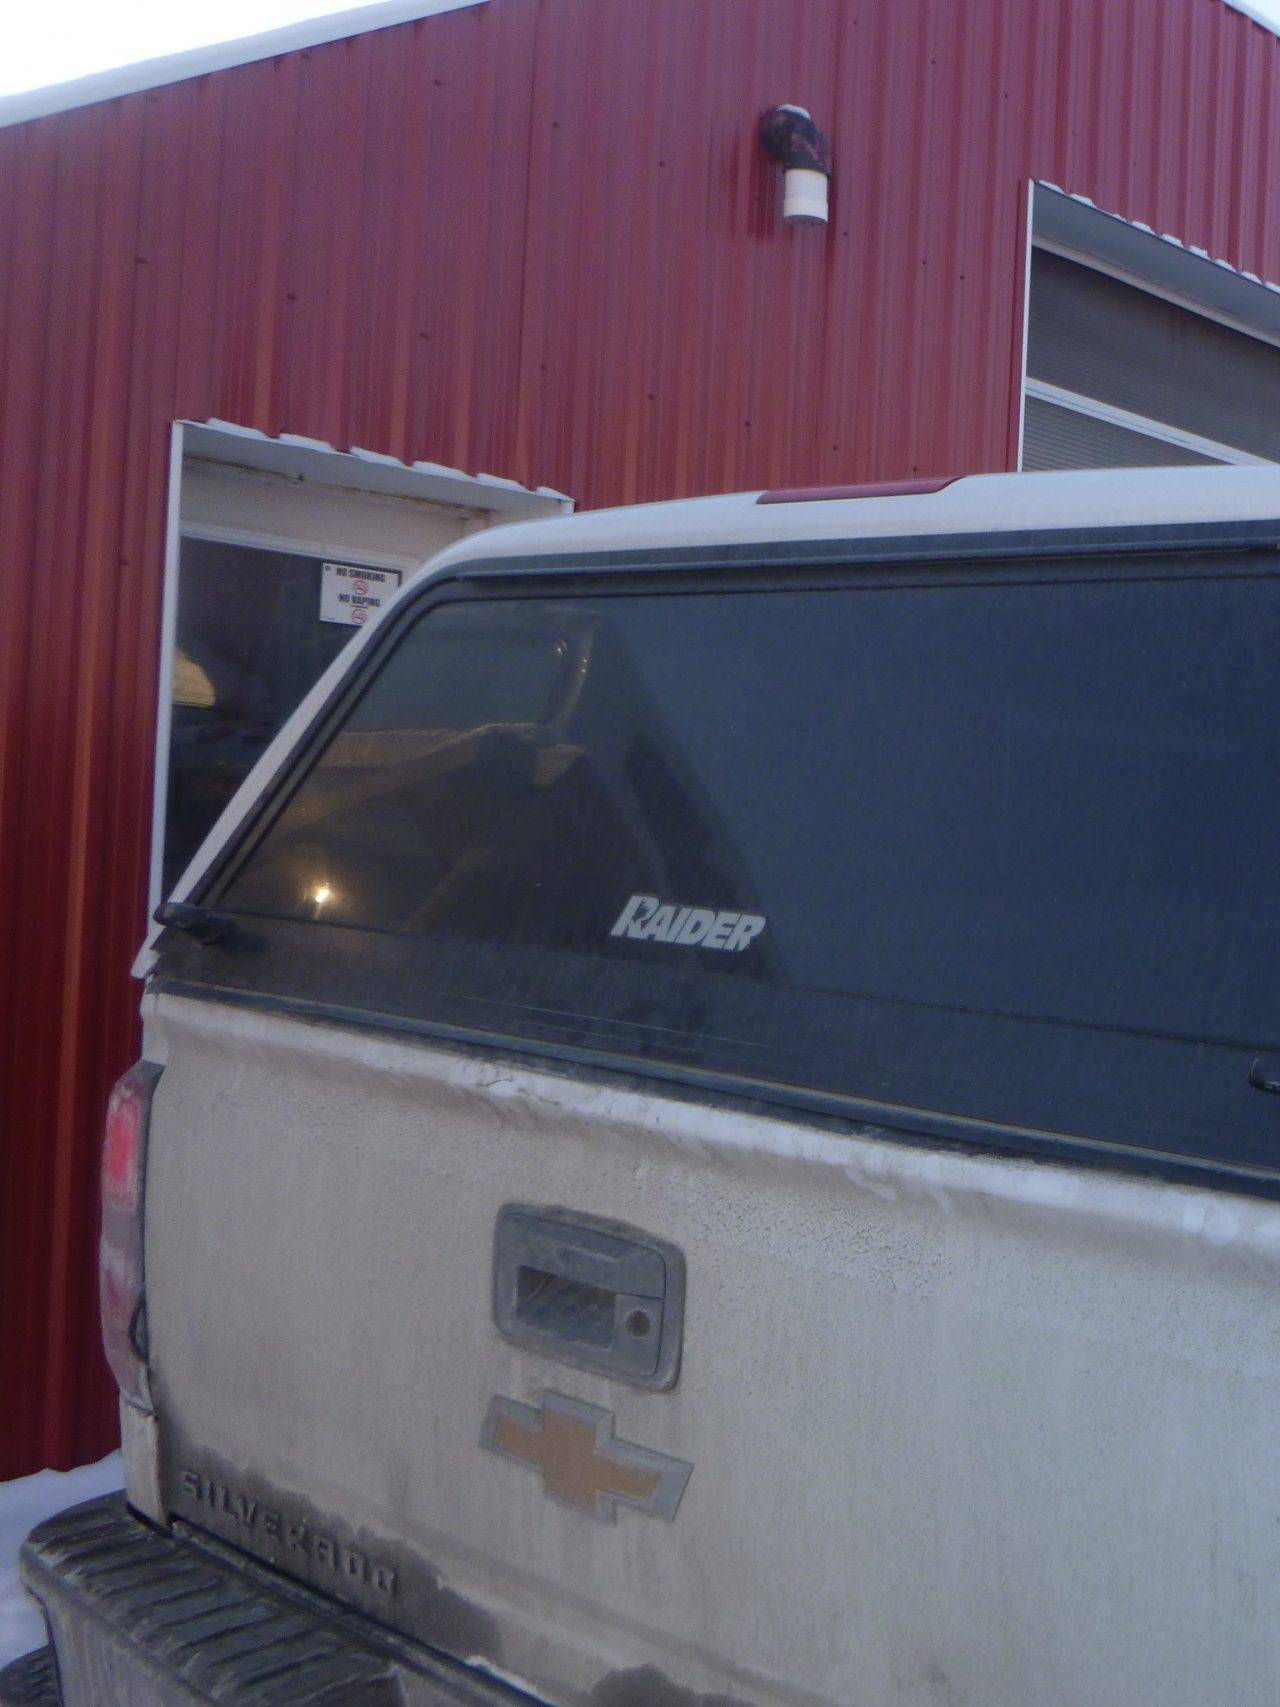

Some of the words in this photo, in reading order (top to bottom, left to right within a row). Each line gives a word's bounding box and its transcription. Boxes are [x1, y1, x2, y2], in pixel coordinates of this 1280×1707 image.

[336, 567, 347, 577] NO
[349, 569, 386, 582] SMOKING
[339, 593, 350, 603] NO
[610, 895, 767, 951] RAIDER
[182, 1471, 397, 1596] SILVERADO
